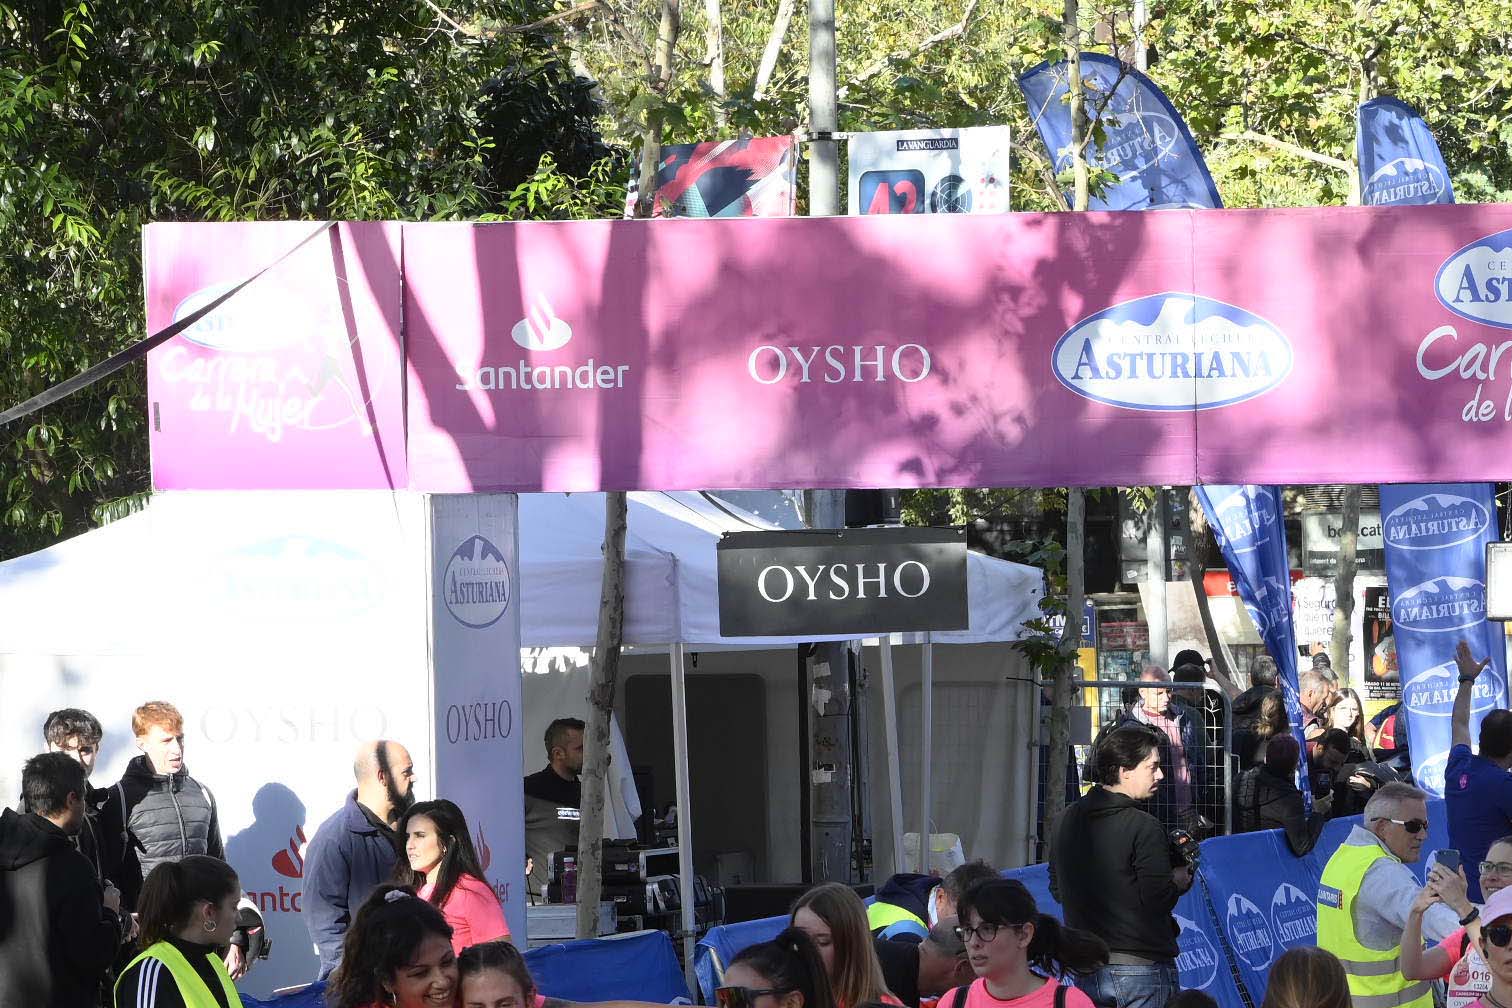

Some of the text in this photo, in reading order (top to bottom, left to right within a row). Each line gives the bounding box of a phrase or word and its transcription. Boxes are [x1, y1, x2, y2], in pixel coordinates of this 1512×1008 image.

[455, 358, 629, 391] Santander
[748, 343, 931, 385] OYSHO
[1071, 337, 1273, 381] ASTURIANA
[1461, 383, 1496, 422] de
[448, 570, 507, 606] ASTURIANA
[757, 560, 931, 602] OYSHO
[446, 700, 513, 744] OYSHO
[1471, 970, 1491, 981] 016
